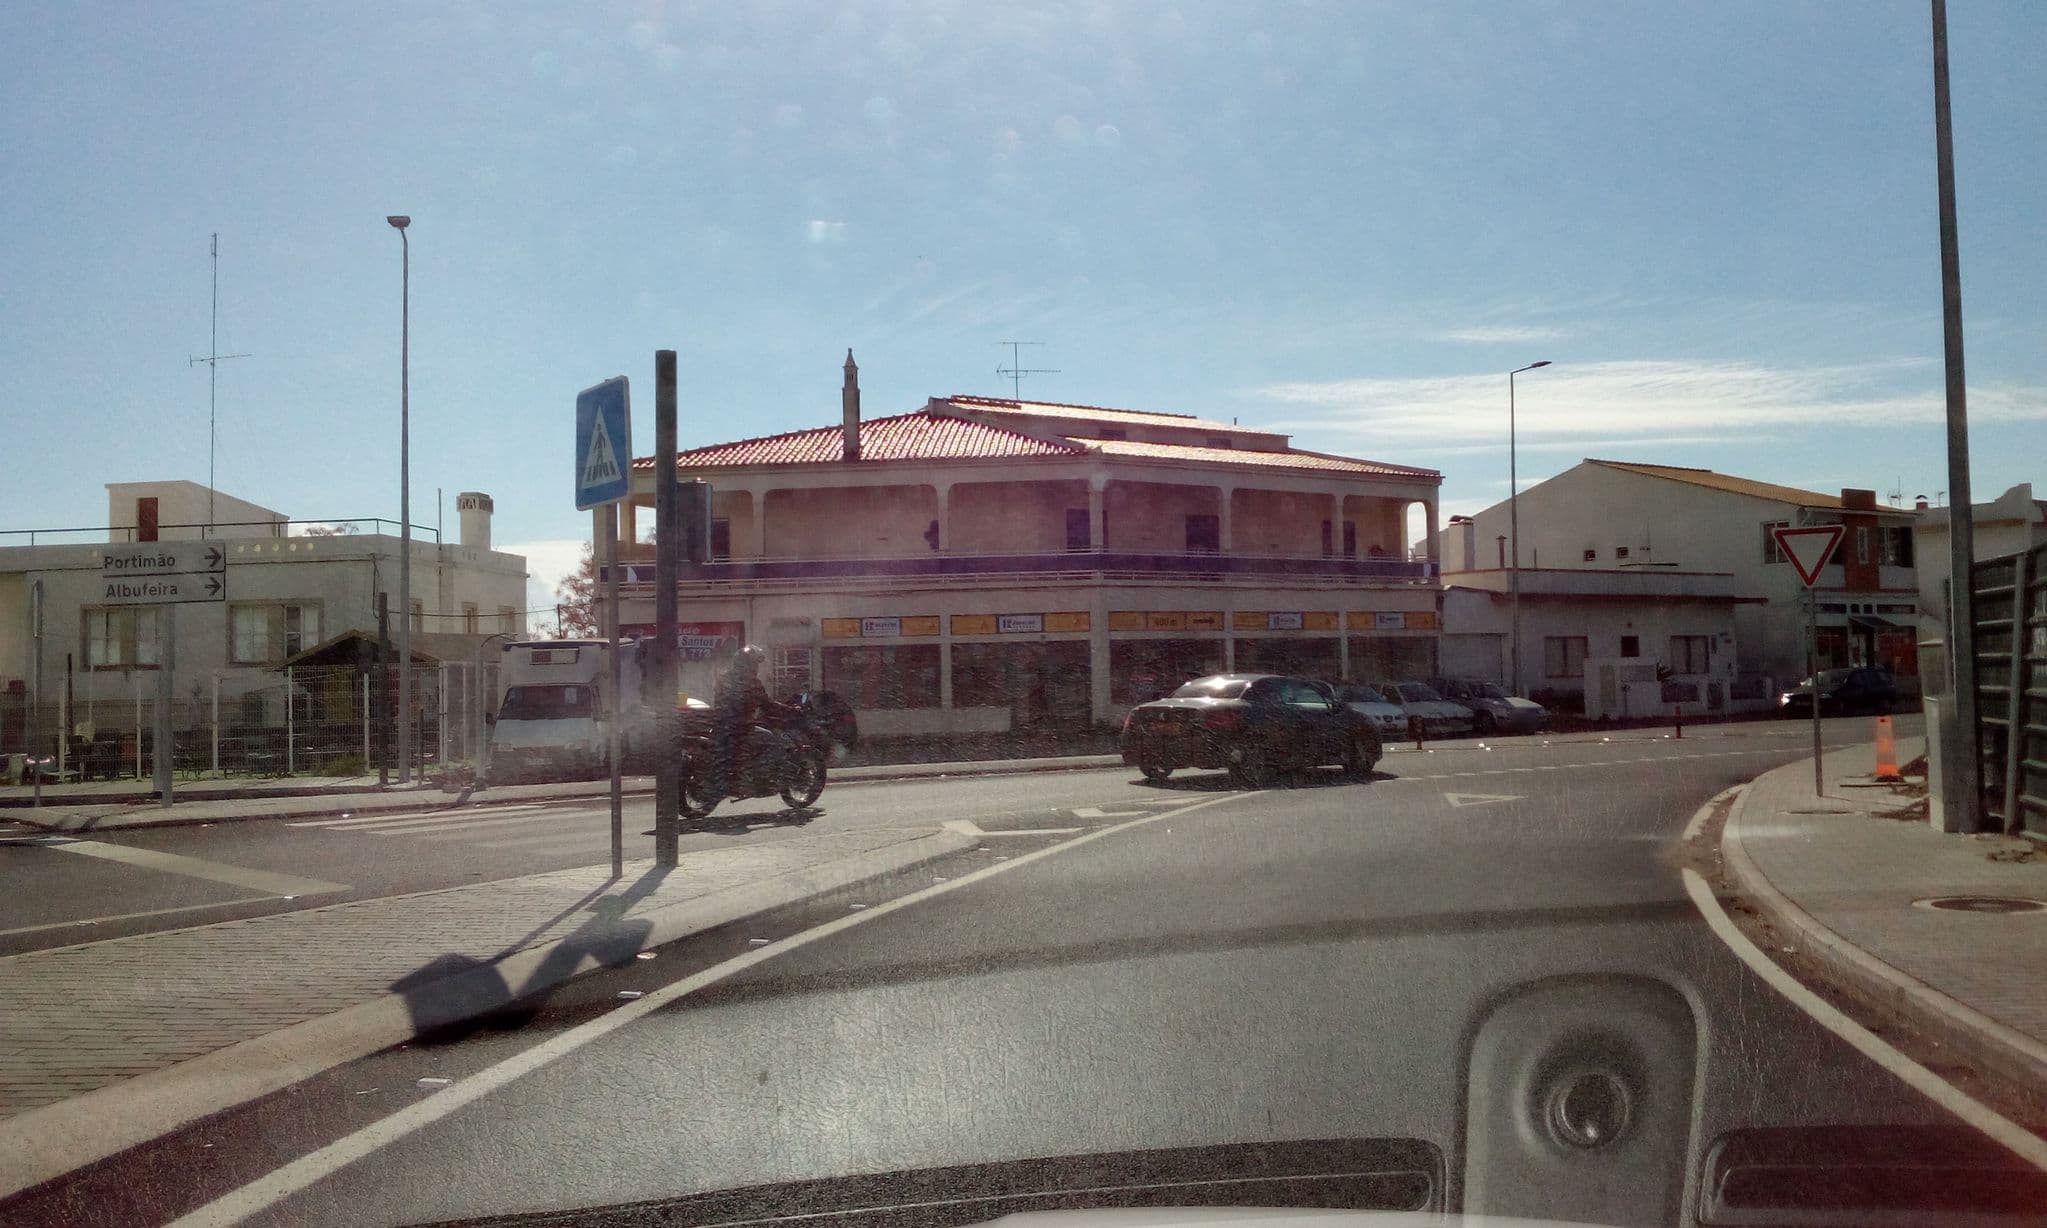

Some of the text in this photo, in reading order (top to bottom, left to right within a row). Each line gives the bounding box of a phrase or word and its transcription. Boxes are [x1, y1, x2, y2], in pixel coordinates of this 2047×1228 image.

[104, 553, 176, 569] Portimão
[105, 583, 178, 598] Albufeira
[681, 636, 714, 646] Santos
